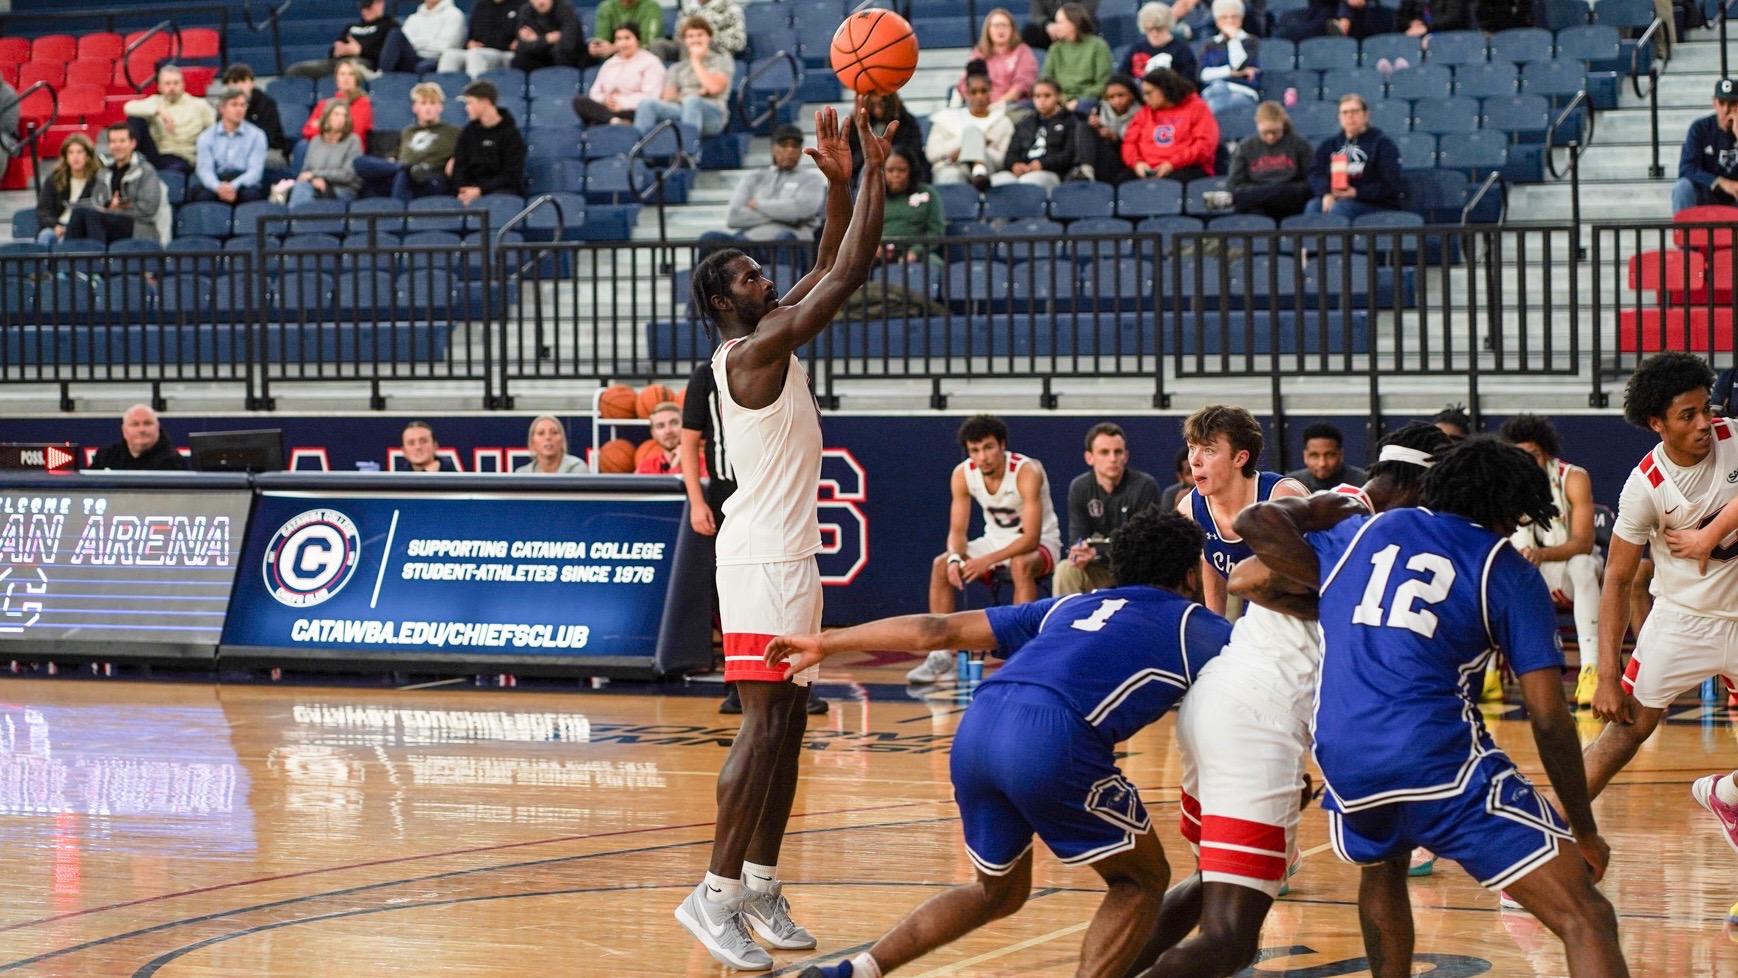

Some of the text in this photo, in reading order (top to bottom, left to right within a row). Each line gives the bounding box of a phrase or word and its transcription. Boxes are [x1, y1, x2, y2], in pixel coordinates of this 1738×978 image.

[1153, 125, 1175, 147] C
[0, 497, 107, 515] LCOME TO
[71, 516, 230, 566] ARENA
[407, 539, 665, 560] SUPPORTING CATAWBA COLLEGE
[292, 537, 332, 579] C
[401, 562, 655, 583] STUDENT-ATHLETES SINCE 1976
[1352, 543, 1456, 639] 12
[1070, 598, 1129, 632] 1
[290, 618, 590, 648] CATAWBA.EDU/CHIEFSCLUB
